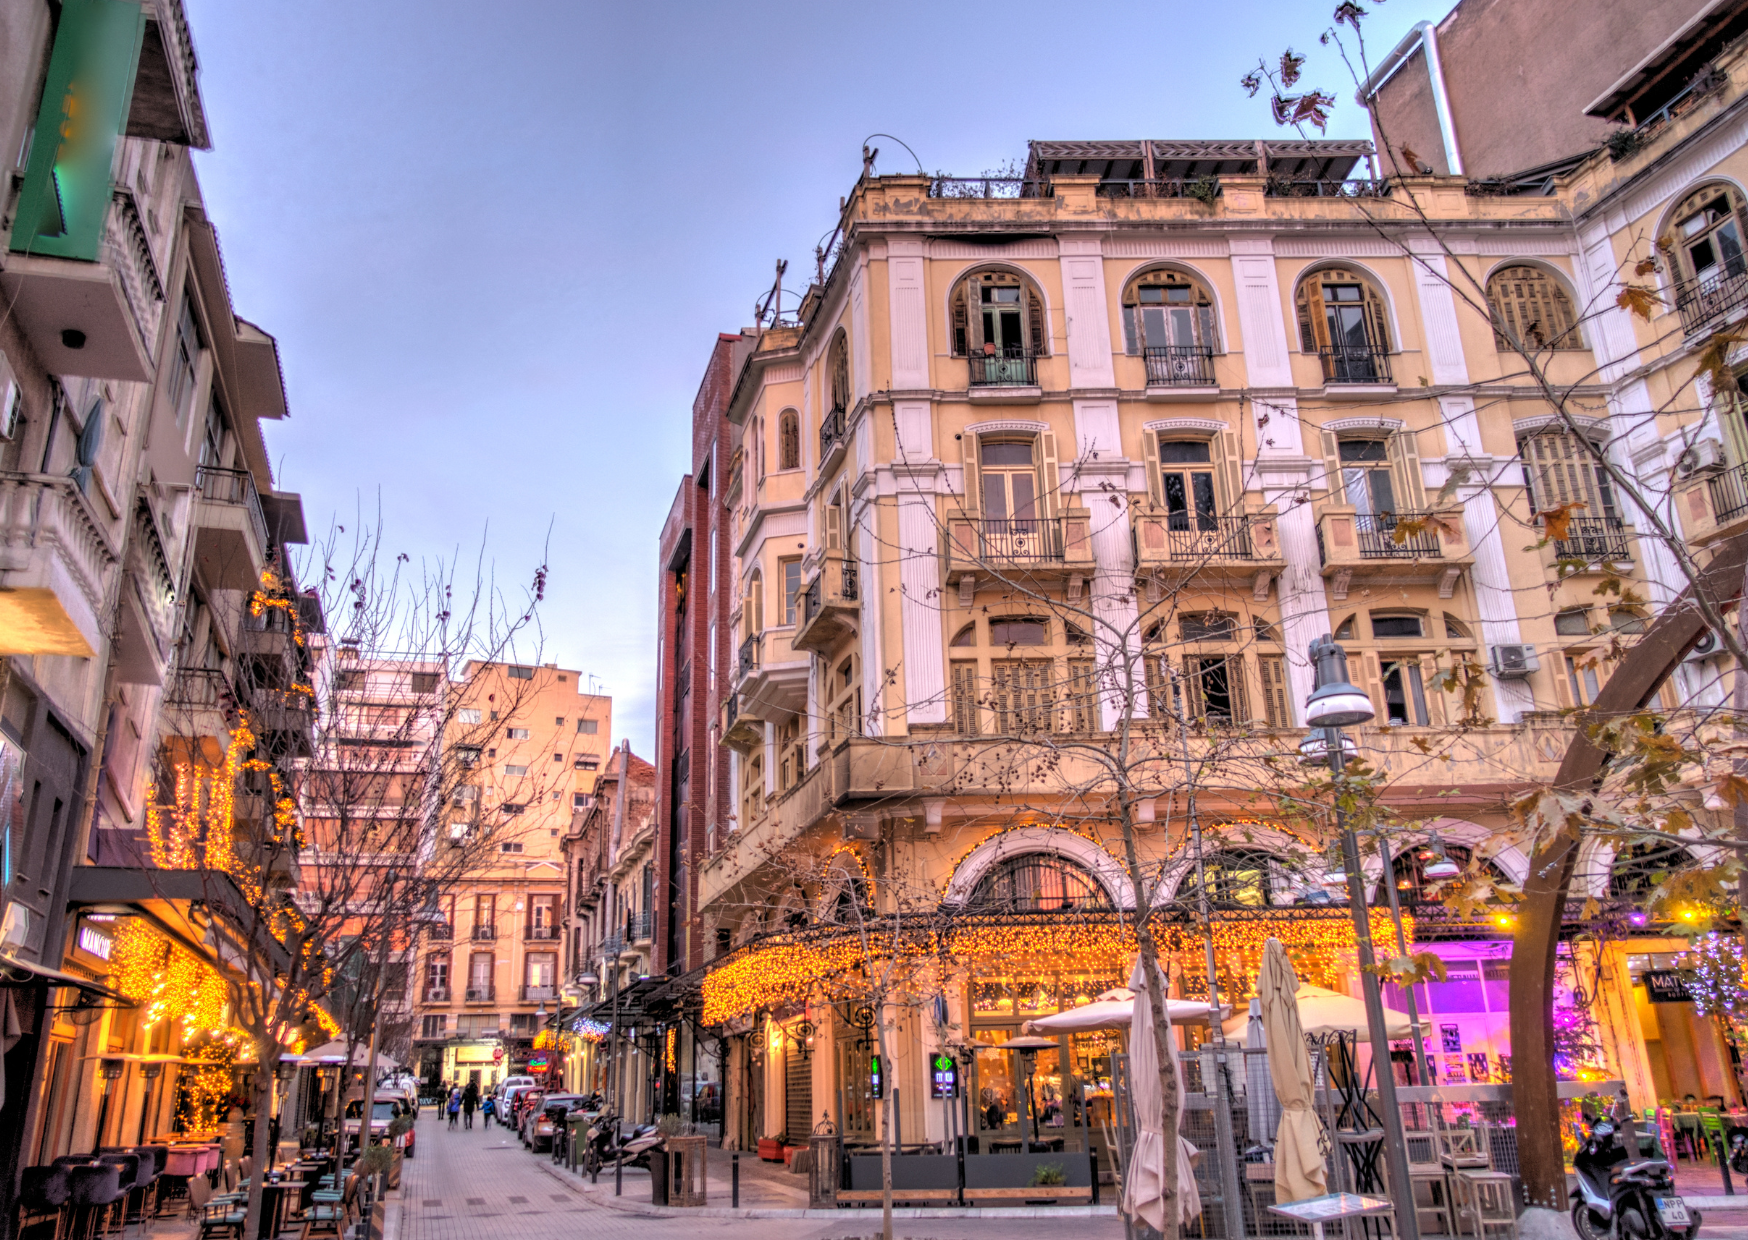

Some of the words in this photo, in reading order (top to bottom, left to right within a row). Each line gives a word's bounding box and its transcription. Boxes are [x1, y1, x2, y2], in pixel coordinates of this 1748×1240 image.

[82, 927, 111, 961] MANOIR
[1663, 1199, 1683, 1209] NPP
[1672, 1211, 1684, 1220] 40
